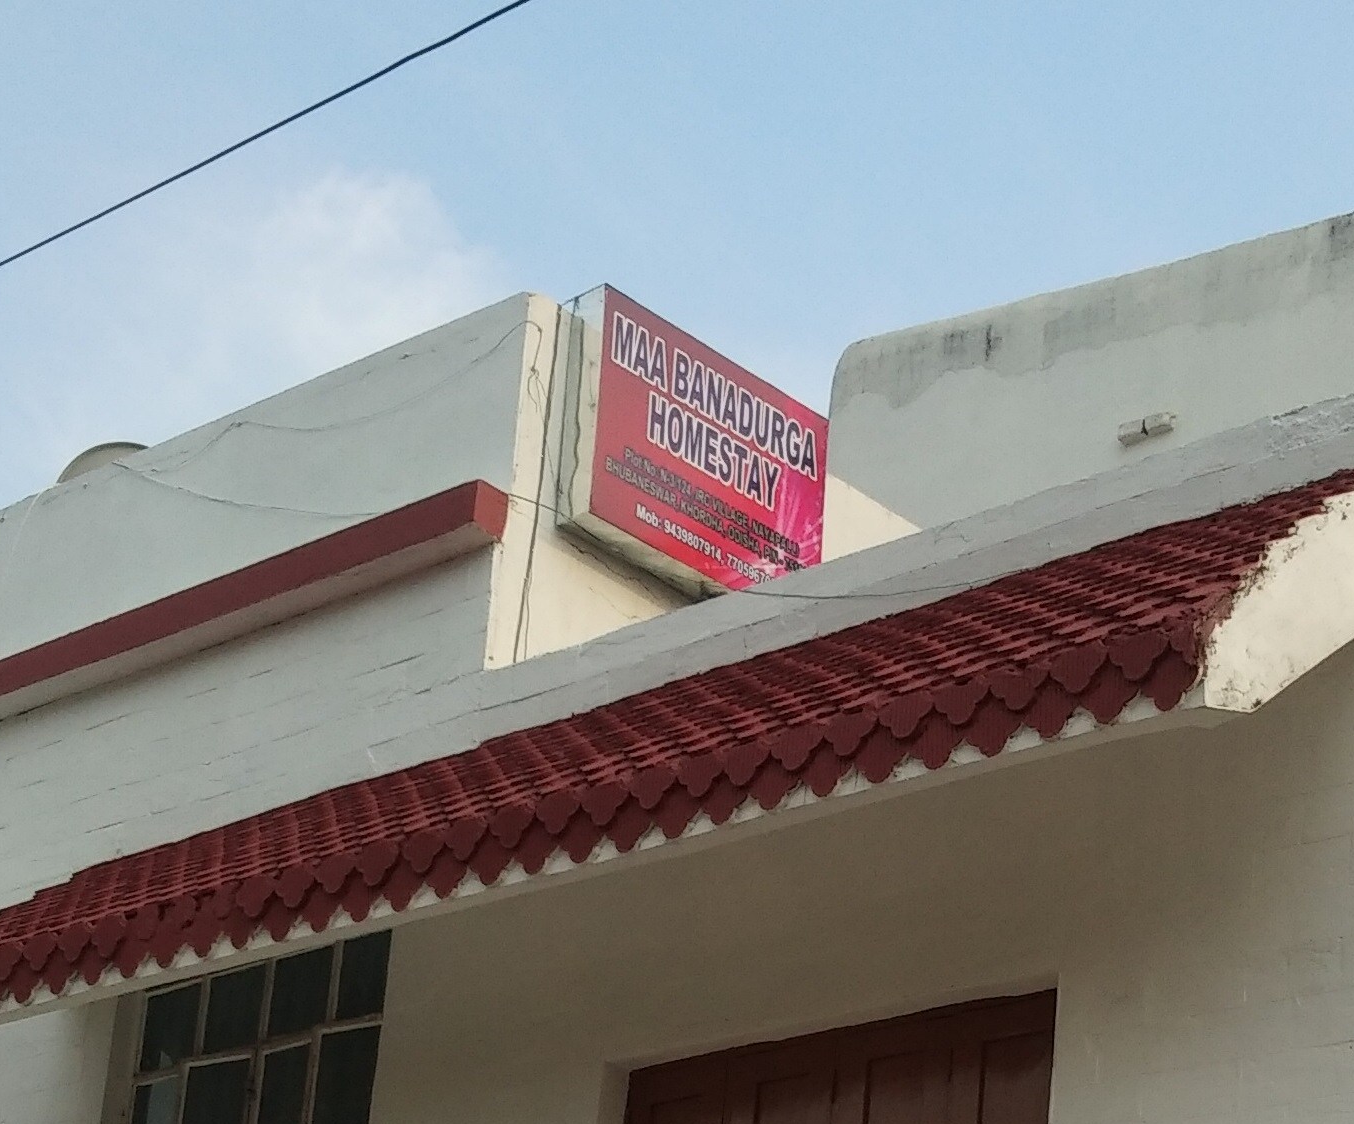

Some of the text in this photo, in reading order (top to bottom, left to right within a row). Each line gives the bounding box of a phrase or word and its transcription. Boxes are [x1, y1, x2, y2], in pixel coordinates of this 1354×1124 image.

[611, 311, 818, 481] MAA BANADURGA
[605, 455, 679, 510] BHUBANESWAR,
[647, 391, 782, 511] HOMESTAY
[636, 503, 662, 530] Mob:
[664, 518, 725, 566] 9439807914,
